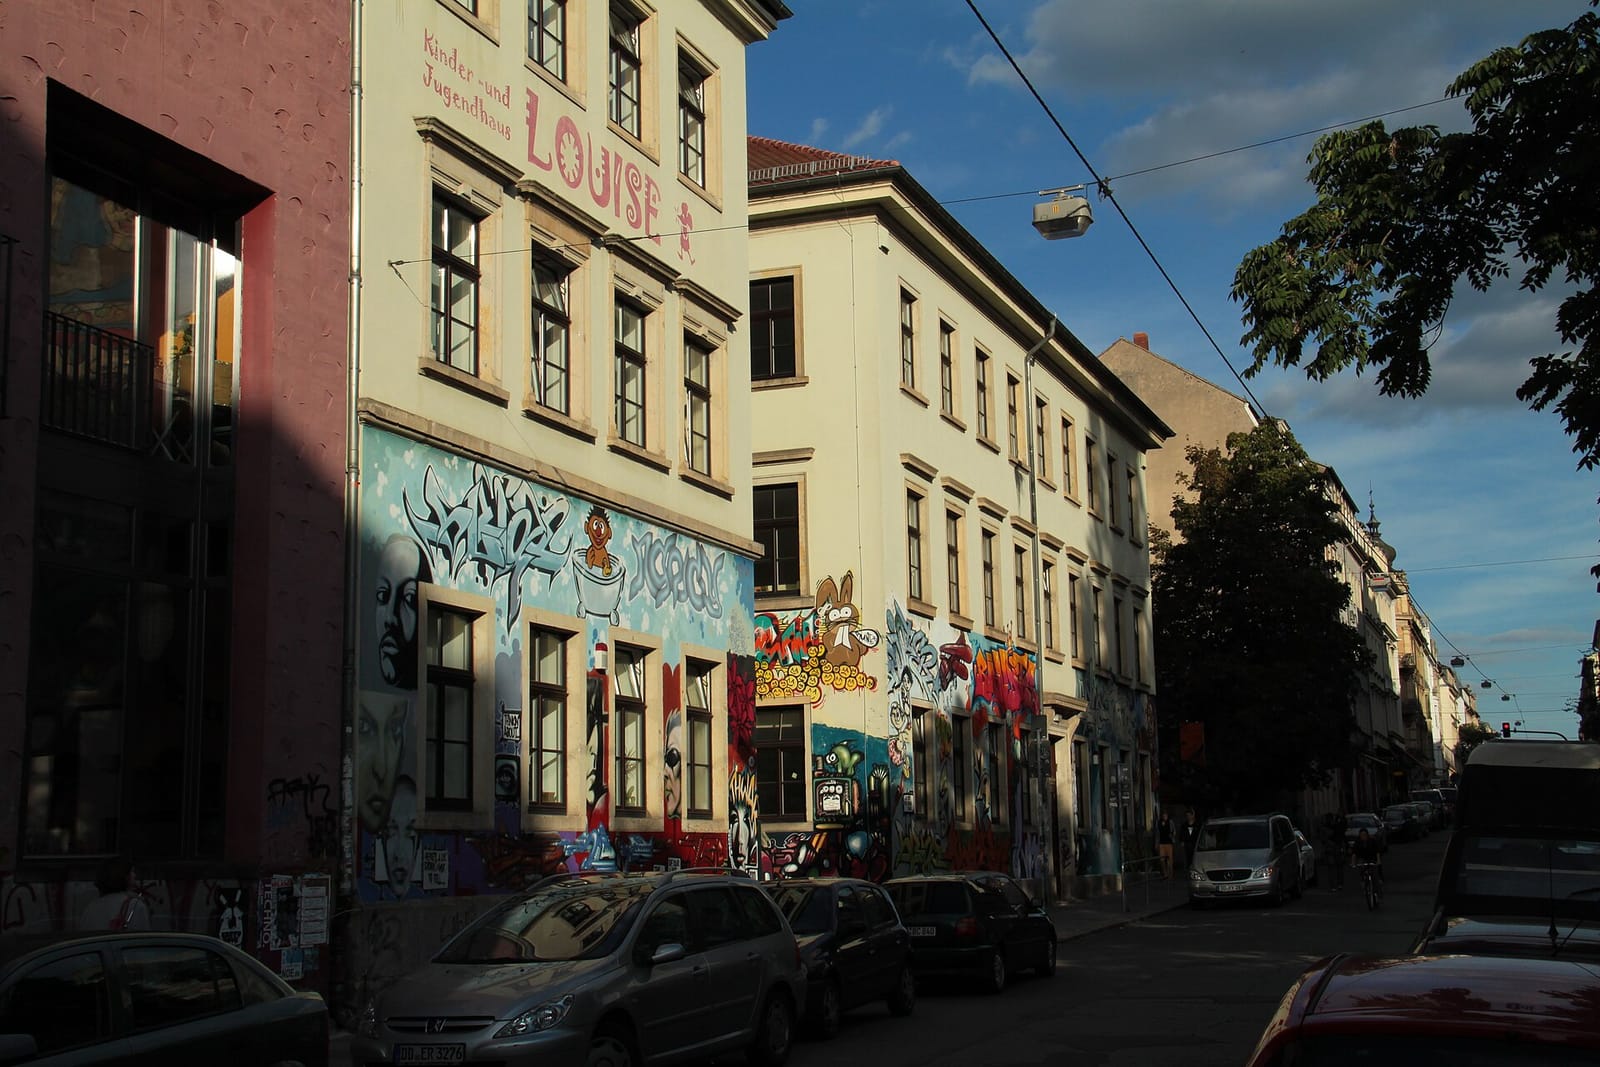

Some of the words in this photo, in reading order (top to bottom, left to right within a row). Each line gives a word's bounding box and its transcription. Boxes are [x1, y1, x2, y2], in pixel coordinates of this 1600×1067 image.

[423, 27, 474, 82] Kinder
[423, 60, 511, 141] Jugendhaus
[525, 87, 662, 247] LOUISE
[401, 1047, 414, 1060] DD
[421, 1047, 434, 1060] ER
[435, 1046, 463, 1060] 3276
